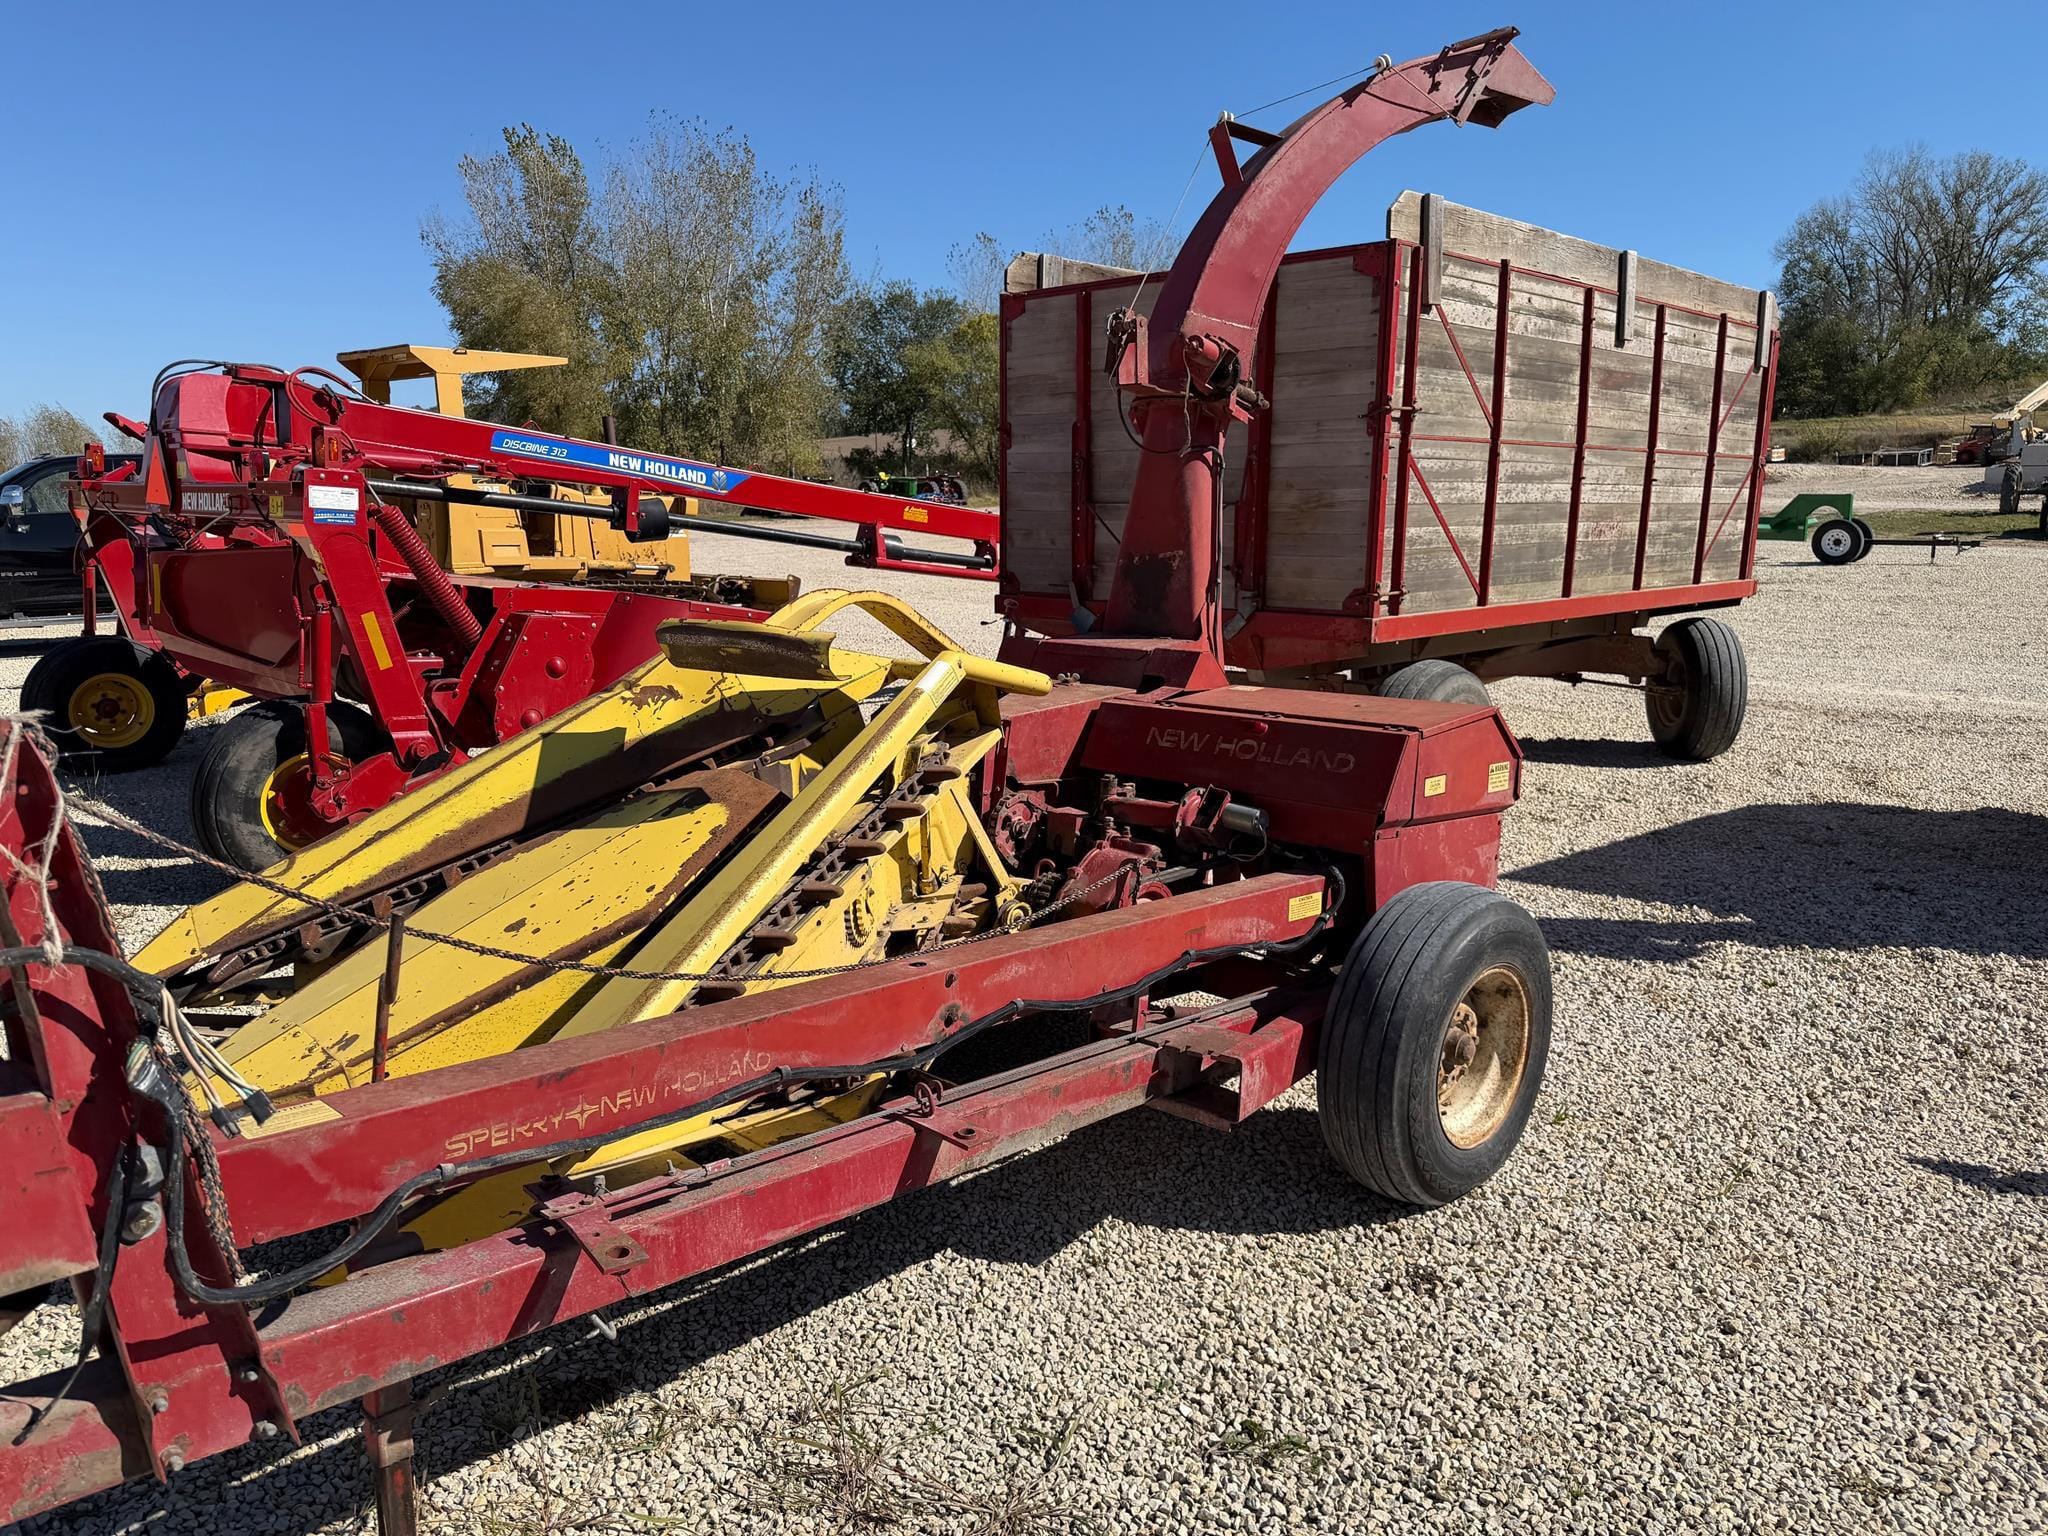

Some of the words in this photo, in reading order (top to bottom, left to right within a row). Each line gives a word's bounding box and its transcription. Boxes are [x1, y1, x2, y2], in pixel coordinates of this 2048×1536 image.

[503, 438, 549, 456] DISCBINE
[550, 447, 568, 458] 313
[609, 452, 641, 471] NEW
[645, 459, 707, 486] HOLLAND
[181, 492, 197, 511] NEW
[1146, 726, 1210, 752] NEW
[1214, 735, 1356, 774] HOLLAND
[445, 1110, 565, 1159] SPERRY
[600, 1085, 657, 1118] NEW
[664, 1050, 772, 1099] HOLLAND
